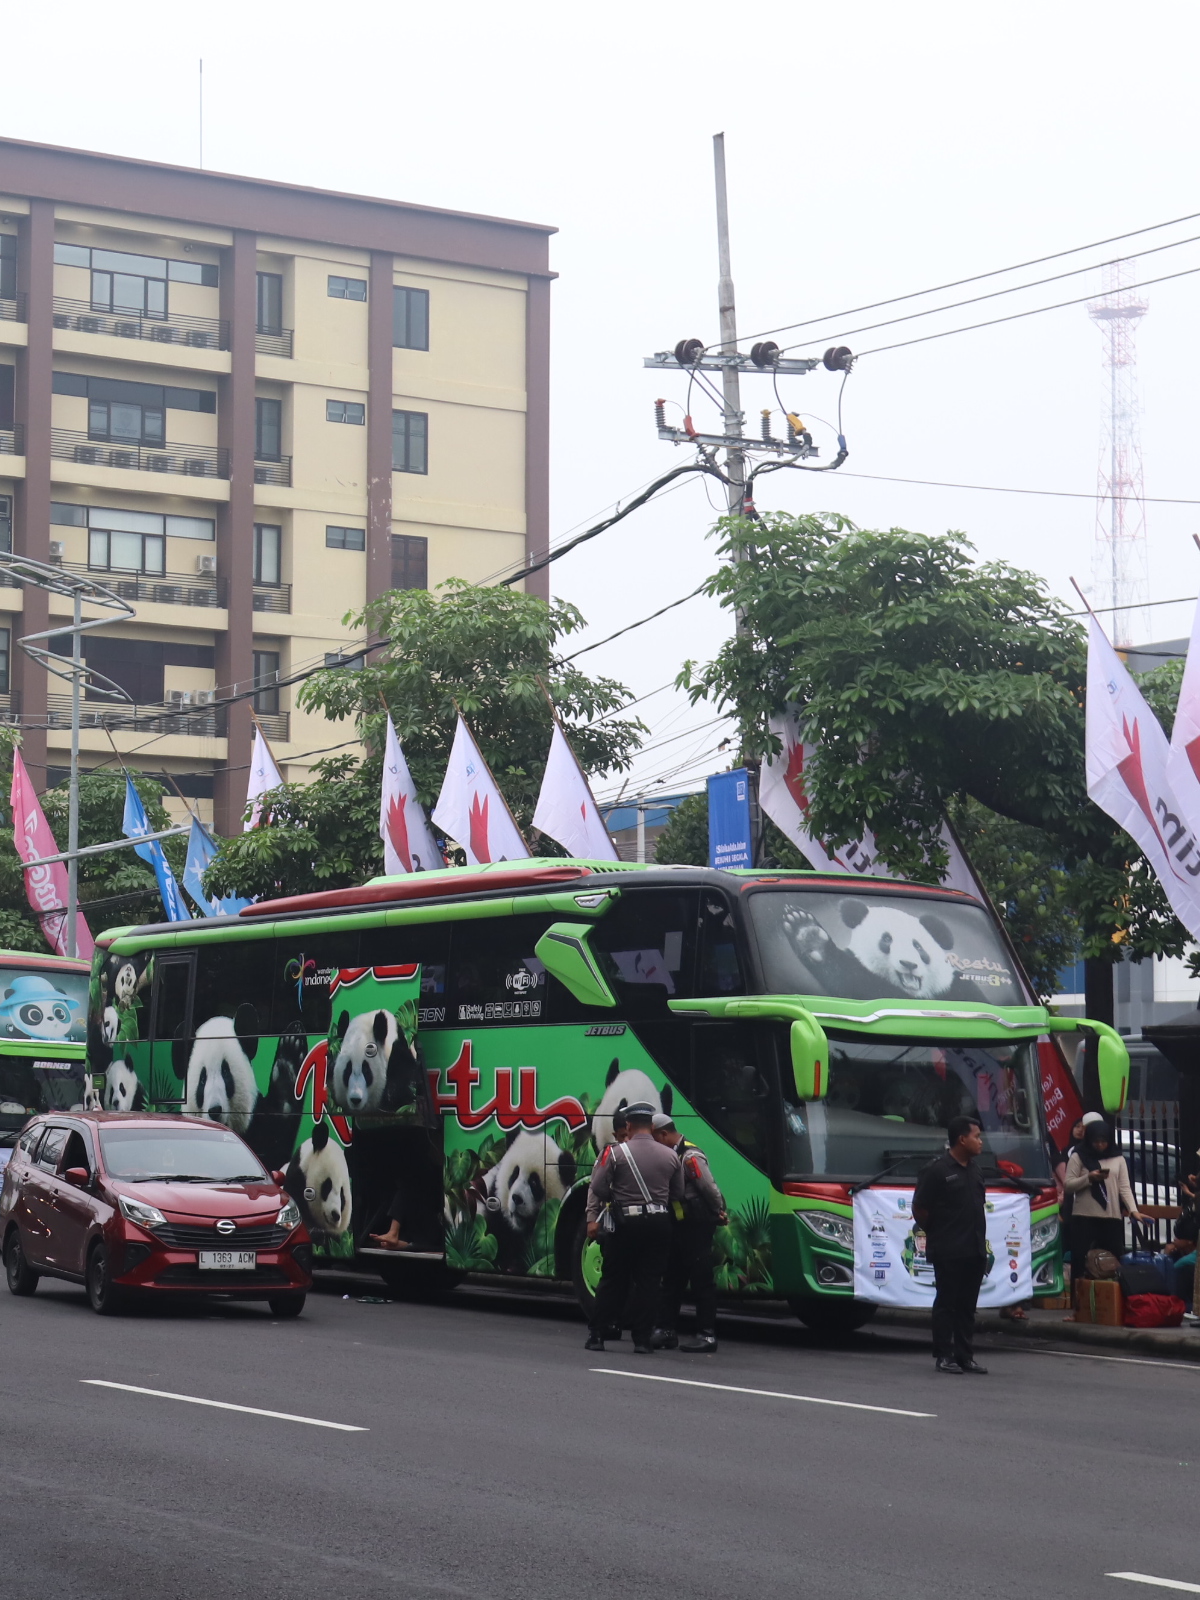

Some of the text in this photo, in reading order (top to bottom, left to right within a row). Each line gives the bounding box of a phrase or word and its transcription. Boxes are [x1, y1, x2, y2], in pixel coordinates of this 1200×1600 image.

[584, 1025, 627, 1037] JETBUS
[33, 1061, 72, 1070] BORNEO
[200, 1252, 255, 1264] L 1363 ACM
